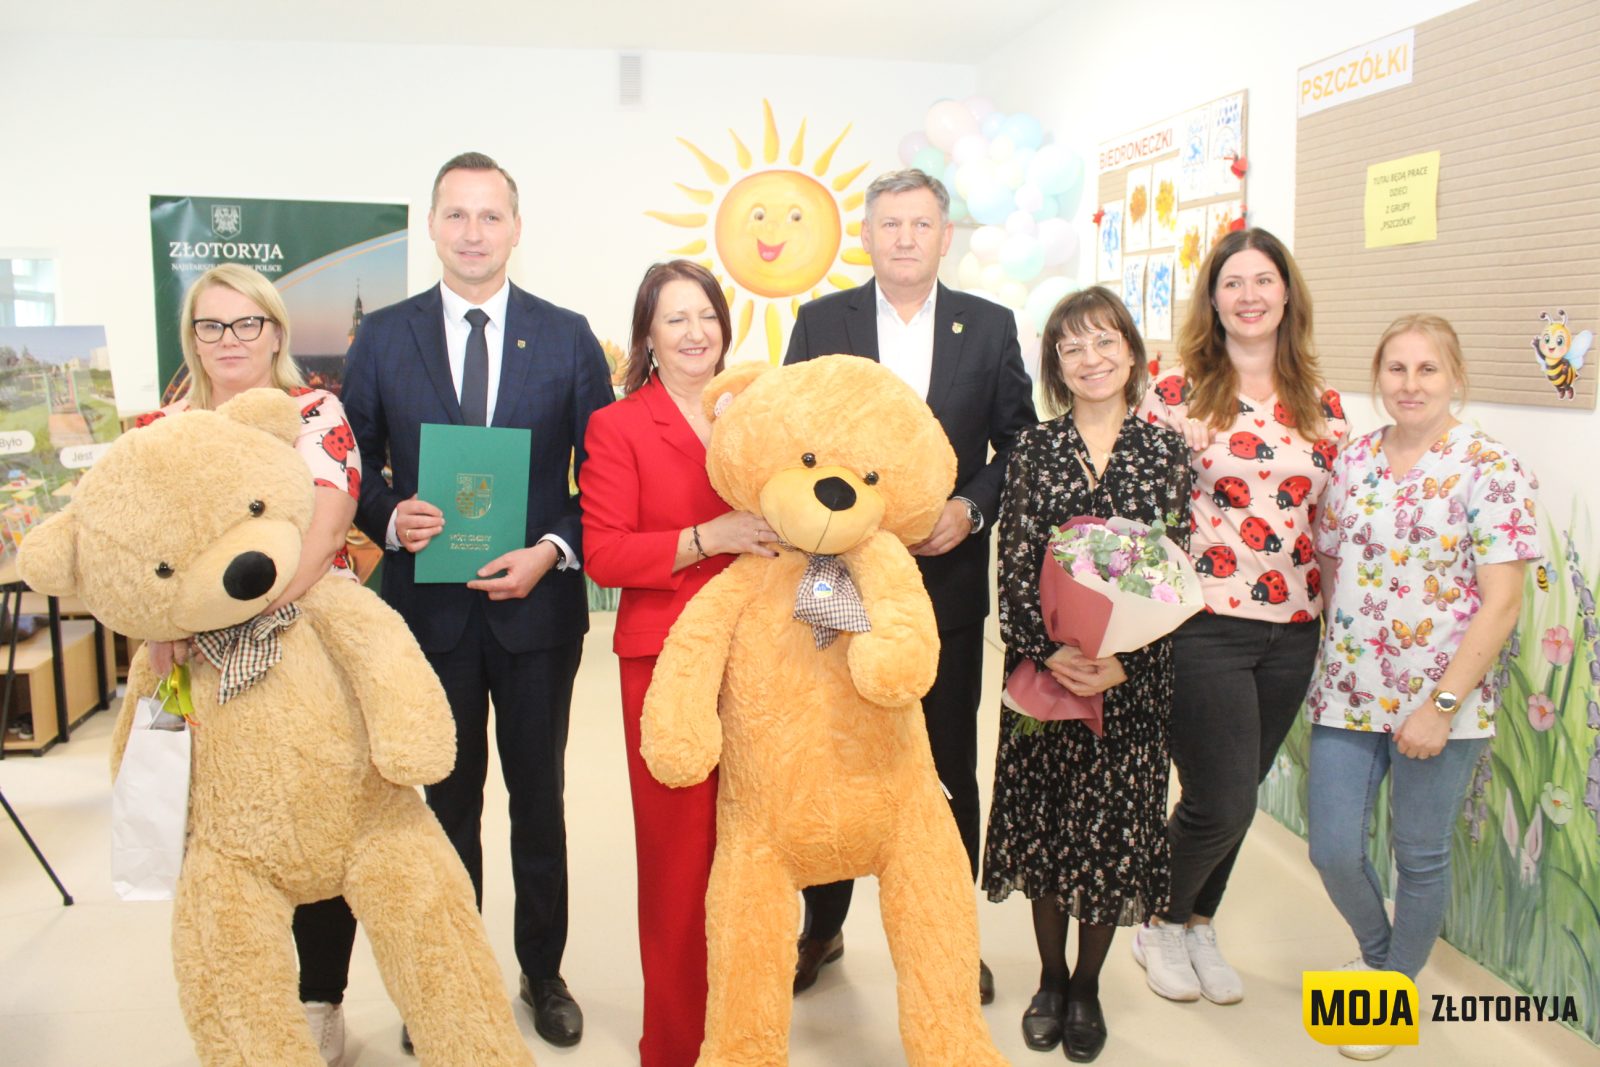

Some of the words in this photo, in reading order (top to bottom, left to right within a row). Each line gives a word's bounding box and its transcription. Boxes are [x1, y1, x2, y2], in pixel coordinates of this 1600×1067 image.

[1301, 43, 1408, 105] PSZCZÓŁKI
[1099, 128, 1173, 170] BIEDRONECZKI
[1407, 166, 1428, 177] PRACE
[1391, 202, 1410, 213] GRUPY
[169, 241, 284, 262] ZŁOTORYJA
[255, 264, 282, 273] POLSCE
[72, 451, 94, 463] Jest
